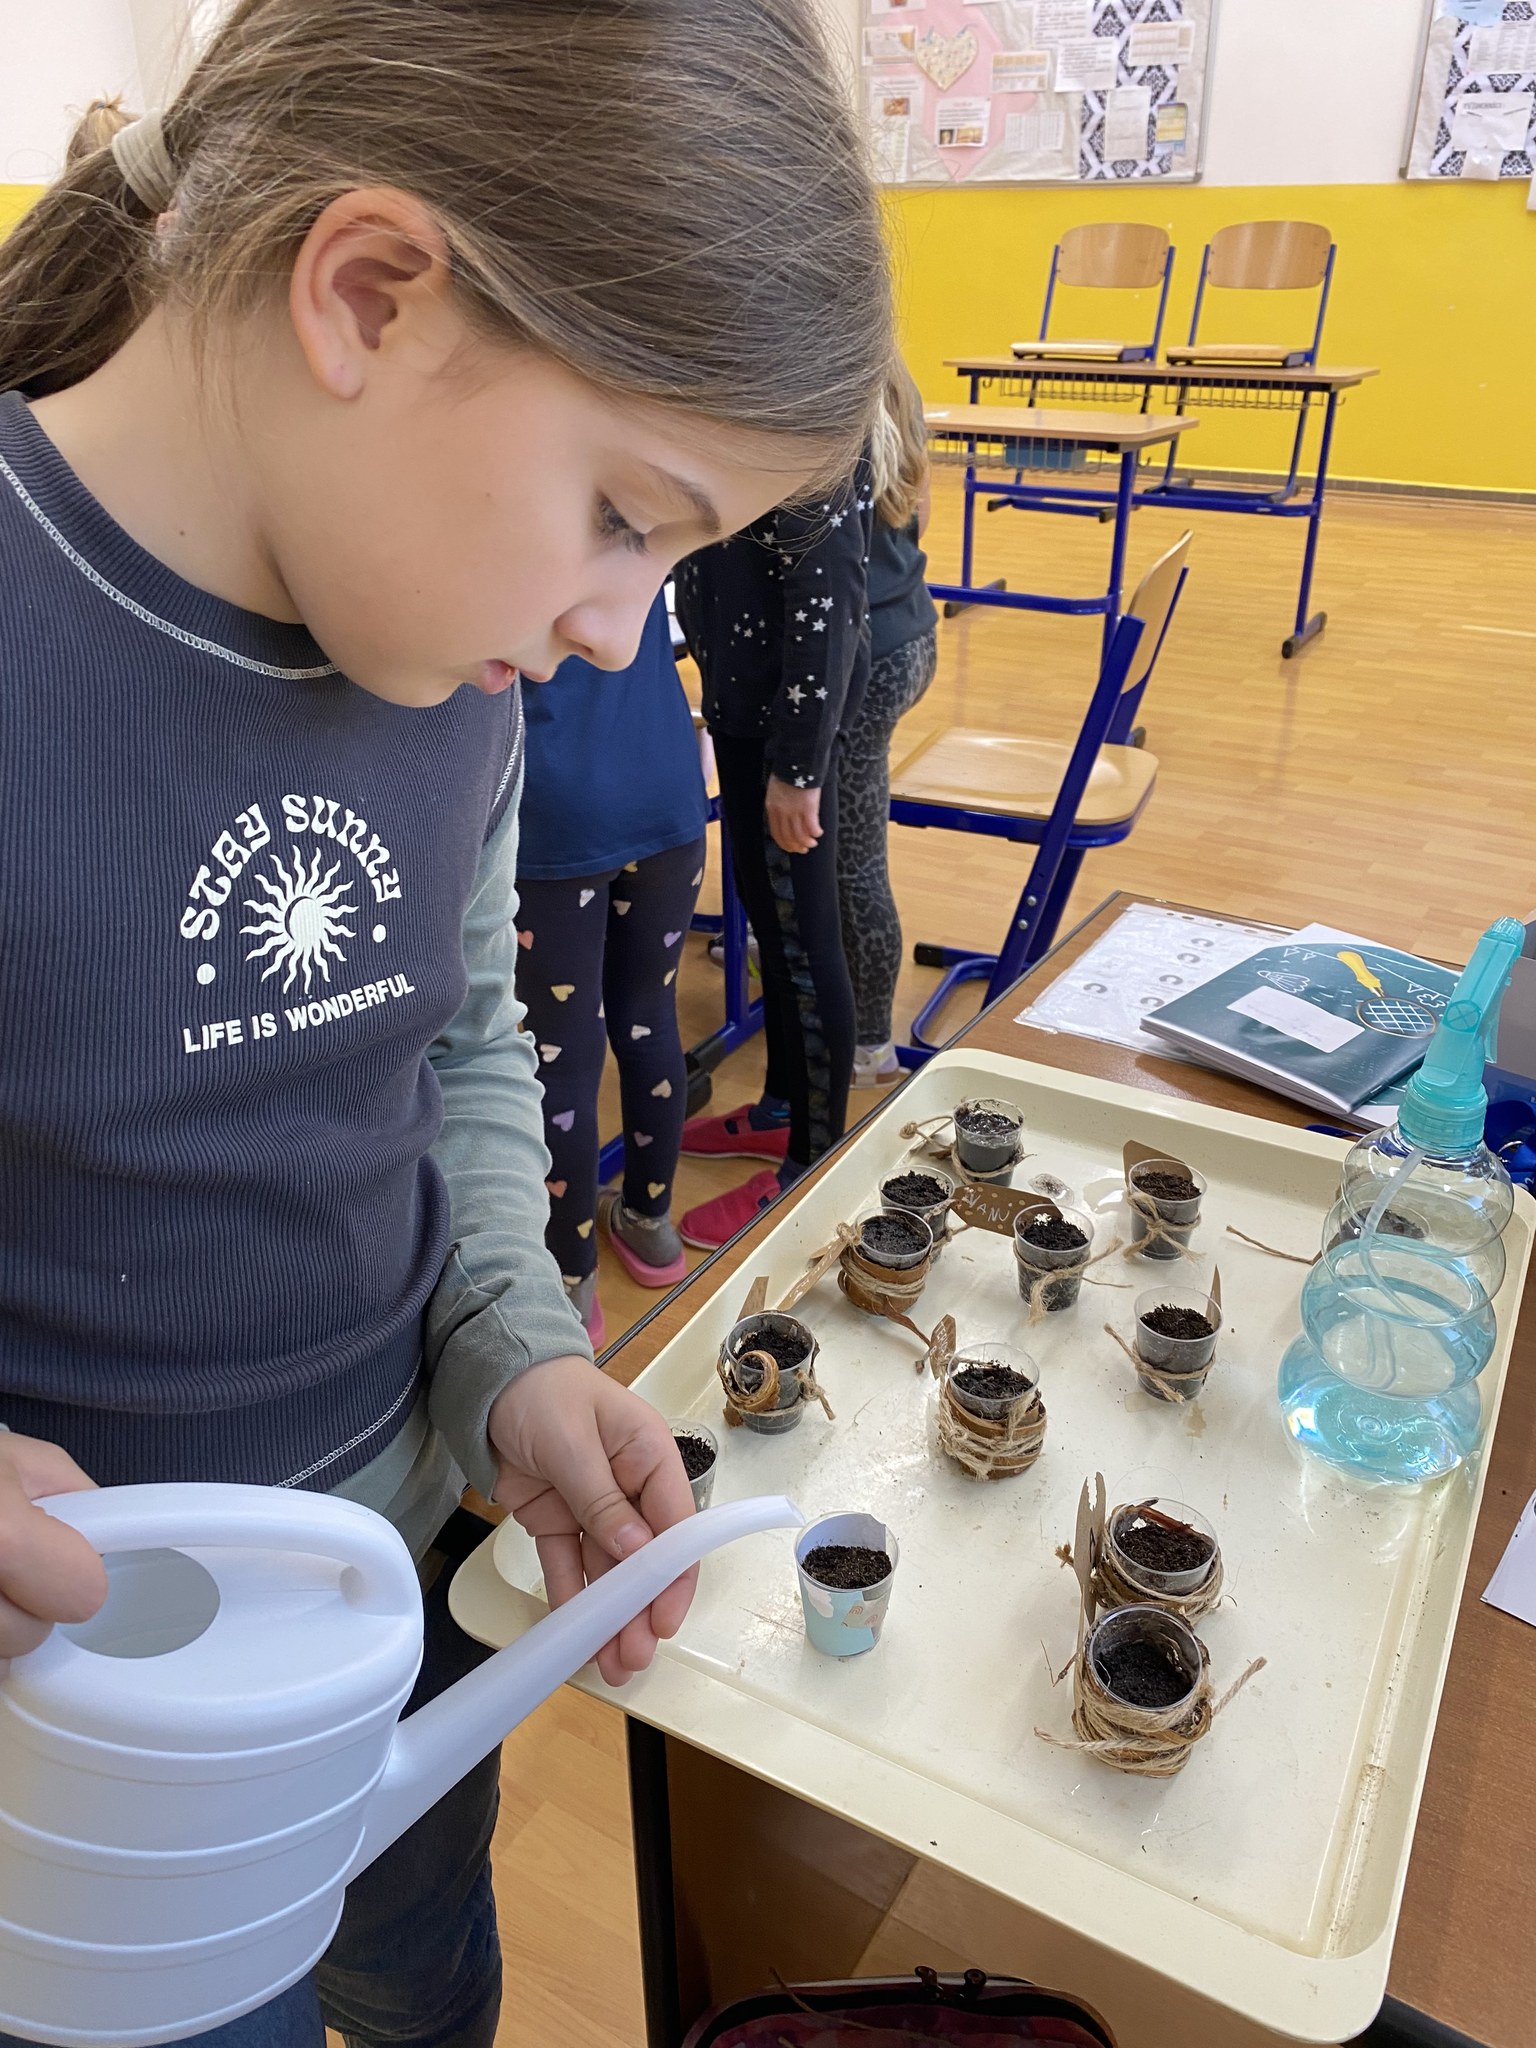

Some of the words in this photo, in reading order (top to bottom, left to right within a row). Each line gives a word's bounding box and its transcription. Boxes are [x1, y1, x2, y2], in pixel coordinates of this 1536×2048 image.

[183, 1019, 244, 1054] LIFE
[251, 1012, 278, 1040] IS
[284, 973, 416, 1032] WONDERFUL
